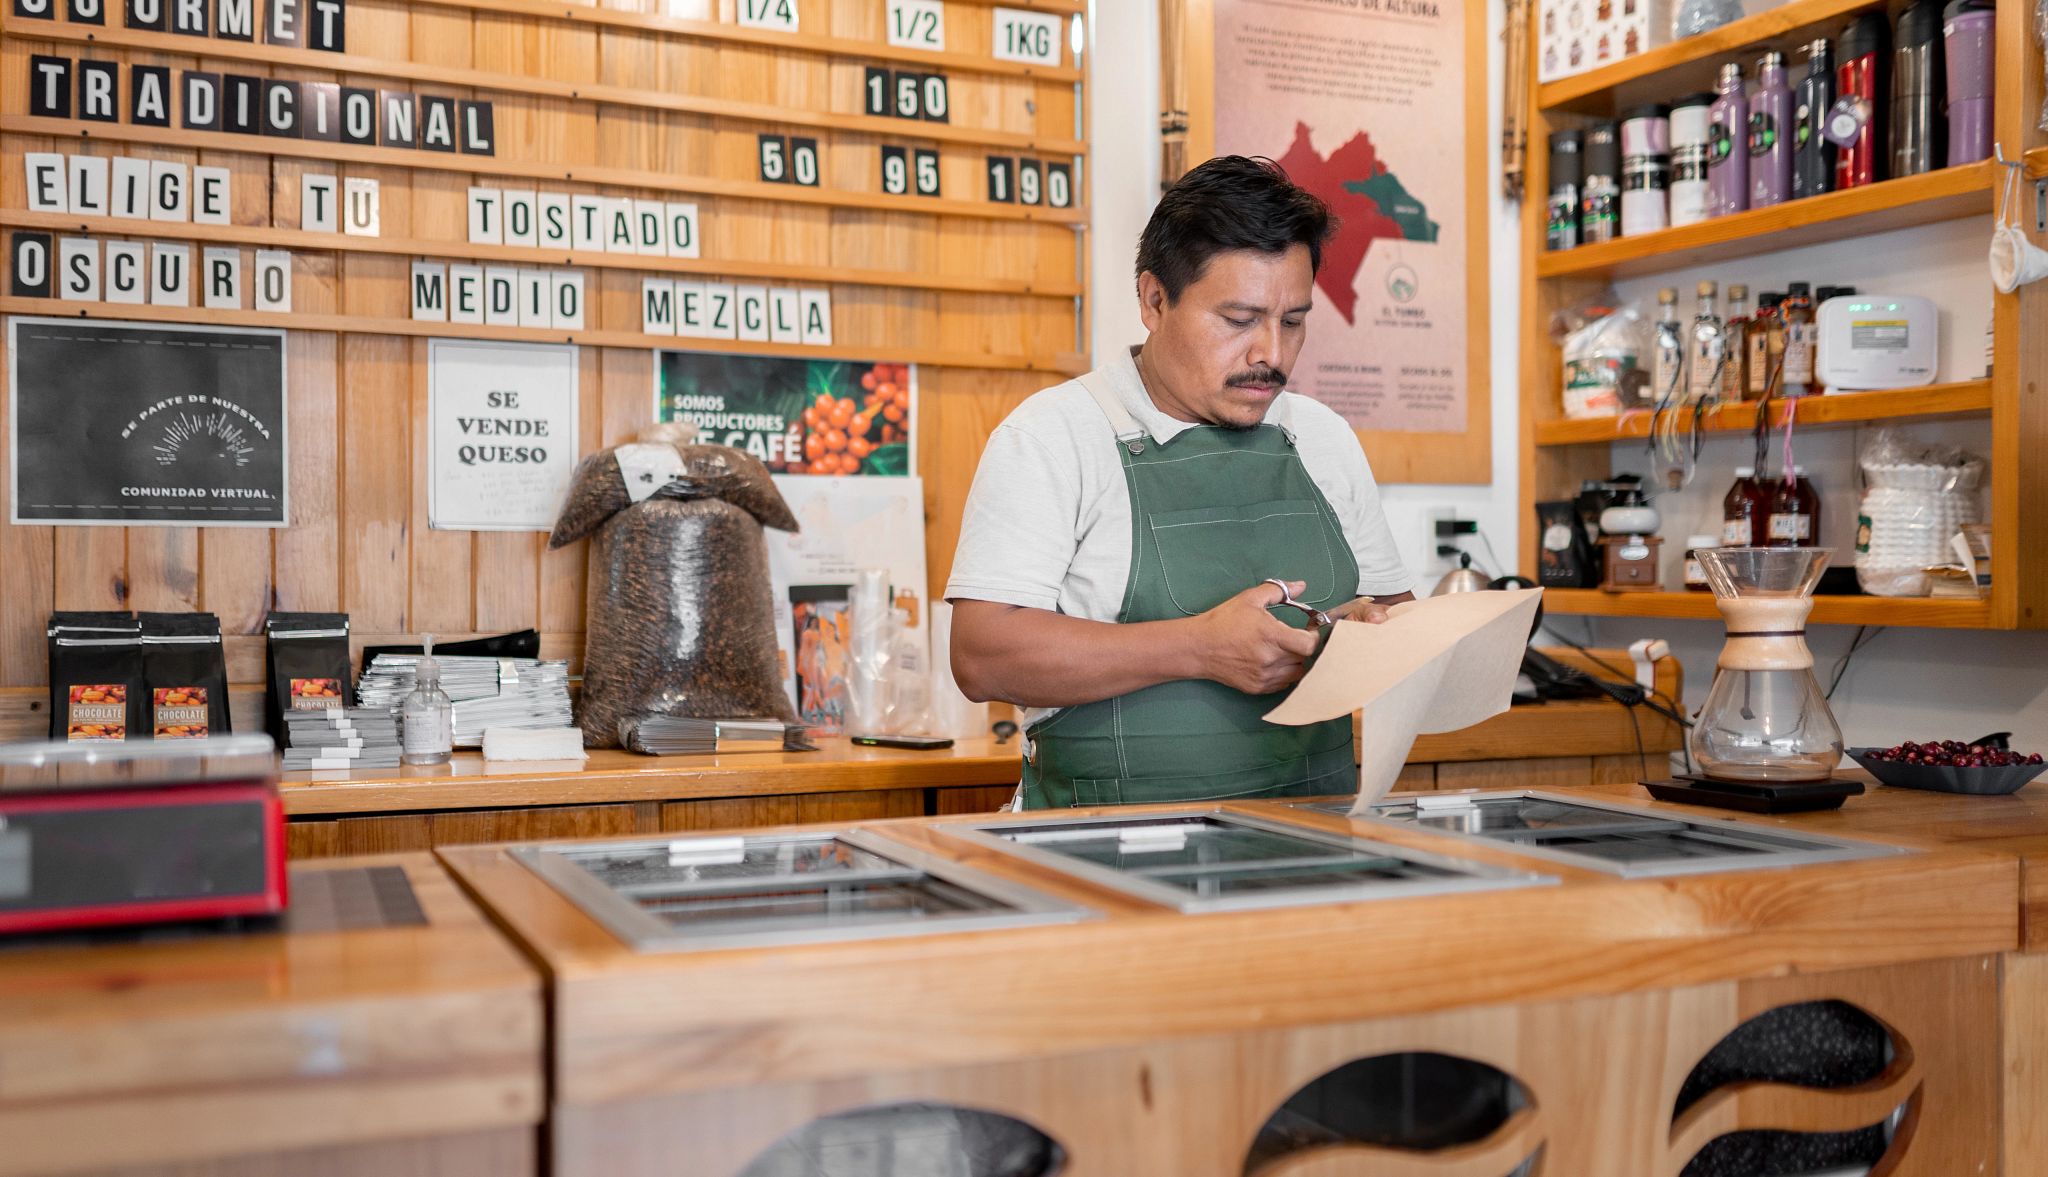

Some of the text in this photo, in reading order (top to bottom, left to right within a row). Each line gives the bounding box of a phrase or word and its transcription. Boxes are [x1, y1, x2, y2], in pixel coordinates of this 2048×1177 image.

[746, 0, 792, 24] 1/4
[894, 8, 939, 43] 1/2
[1003, 21, 1050, 57] 1KG
[39, 64, 490, 151] TRADICIONAL
[870, 75, 947, 117] 150
[763, 141, 817, 184] 50
[885, 150, 938, 194] 95
[993, 164, 1069, 206] 190
[36, 165, 691, 248] ELIGE TU TOSTADO
[19, 246, 825, 335] OSCURO MEDIO MEZCLA
[139, 395, 183, 421] PARTE
[188, 394, 207, 404] DE
[212, 396, 270, 440] NUESTRA
[486, 391, 519, 410] SE
[673, 394, 725, 411] SOMOS
[457, 418, 549, 438] VENDE
[673, 411, 785, 432] PRODUCTORES
[458, 444, 548, 466] QUESO
[121, 486, 207, 498] COMUNIDAD
[73, 708, 122, 719] CHOCOLATE
[157, 709, 206, 721] CHOCOLATE
